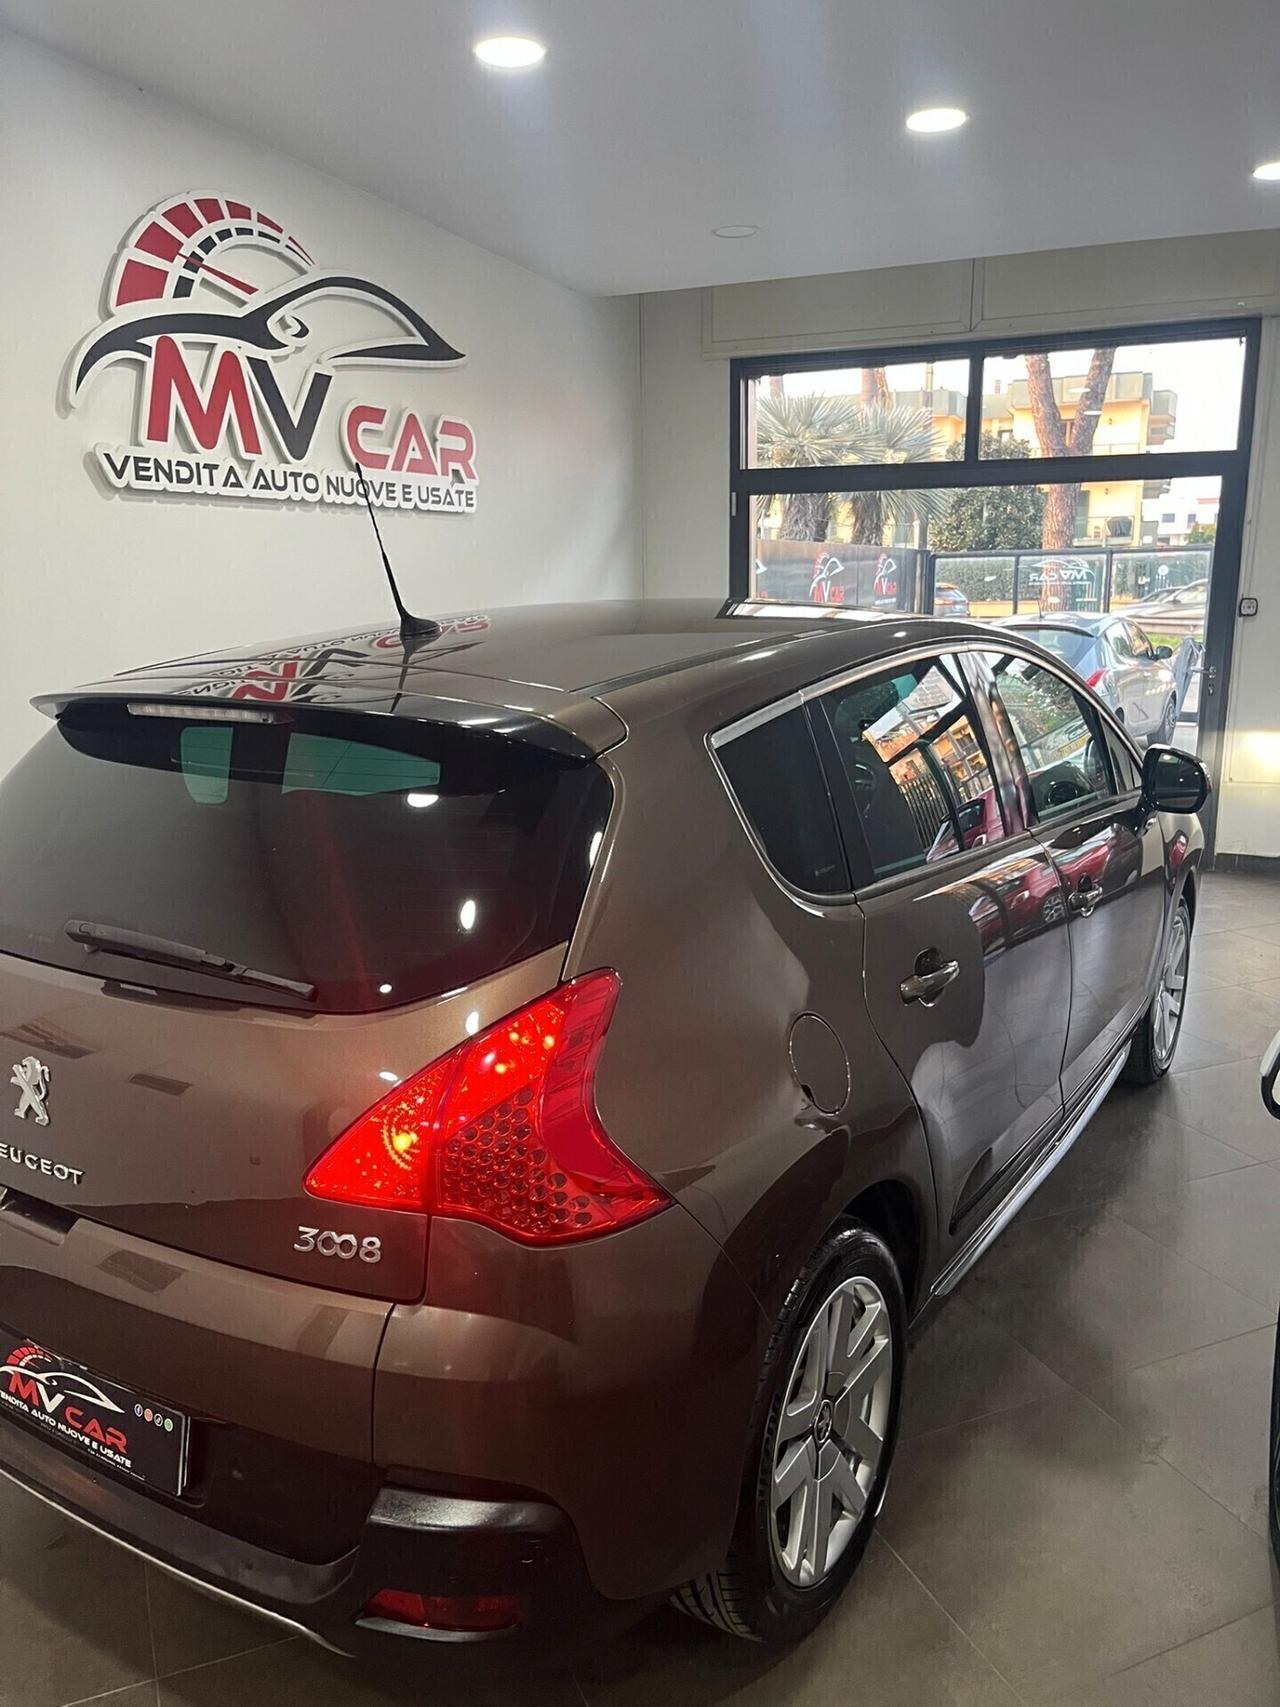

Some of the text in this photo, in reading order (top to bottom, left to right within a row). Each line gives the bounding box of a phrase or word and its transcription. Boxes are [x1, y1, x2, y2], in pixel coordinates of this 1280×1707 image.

[146, 335, 477, 480] MV CAR
[103, 452, 474, 508] VENDITA AUTO NUOVE E USATE
[0, 1142, 84, 1185] EUGEOT
[293, 1225, 382, 1264] 3008
[0, 1390, 30, 1412] ENDITA
[31, 1408, 56, 1426] AUTO
[57, 1422, 91, 1446] NUOVE
[91, 1441, 99, 1450] E
[99, 1445, 132, 1468] USATE
[8, 1371, 65, 1414] MV
[64, 1405, 128, 1454] CAR
